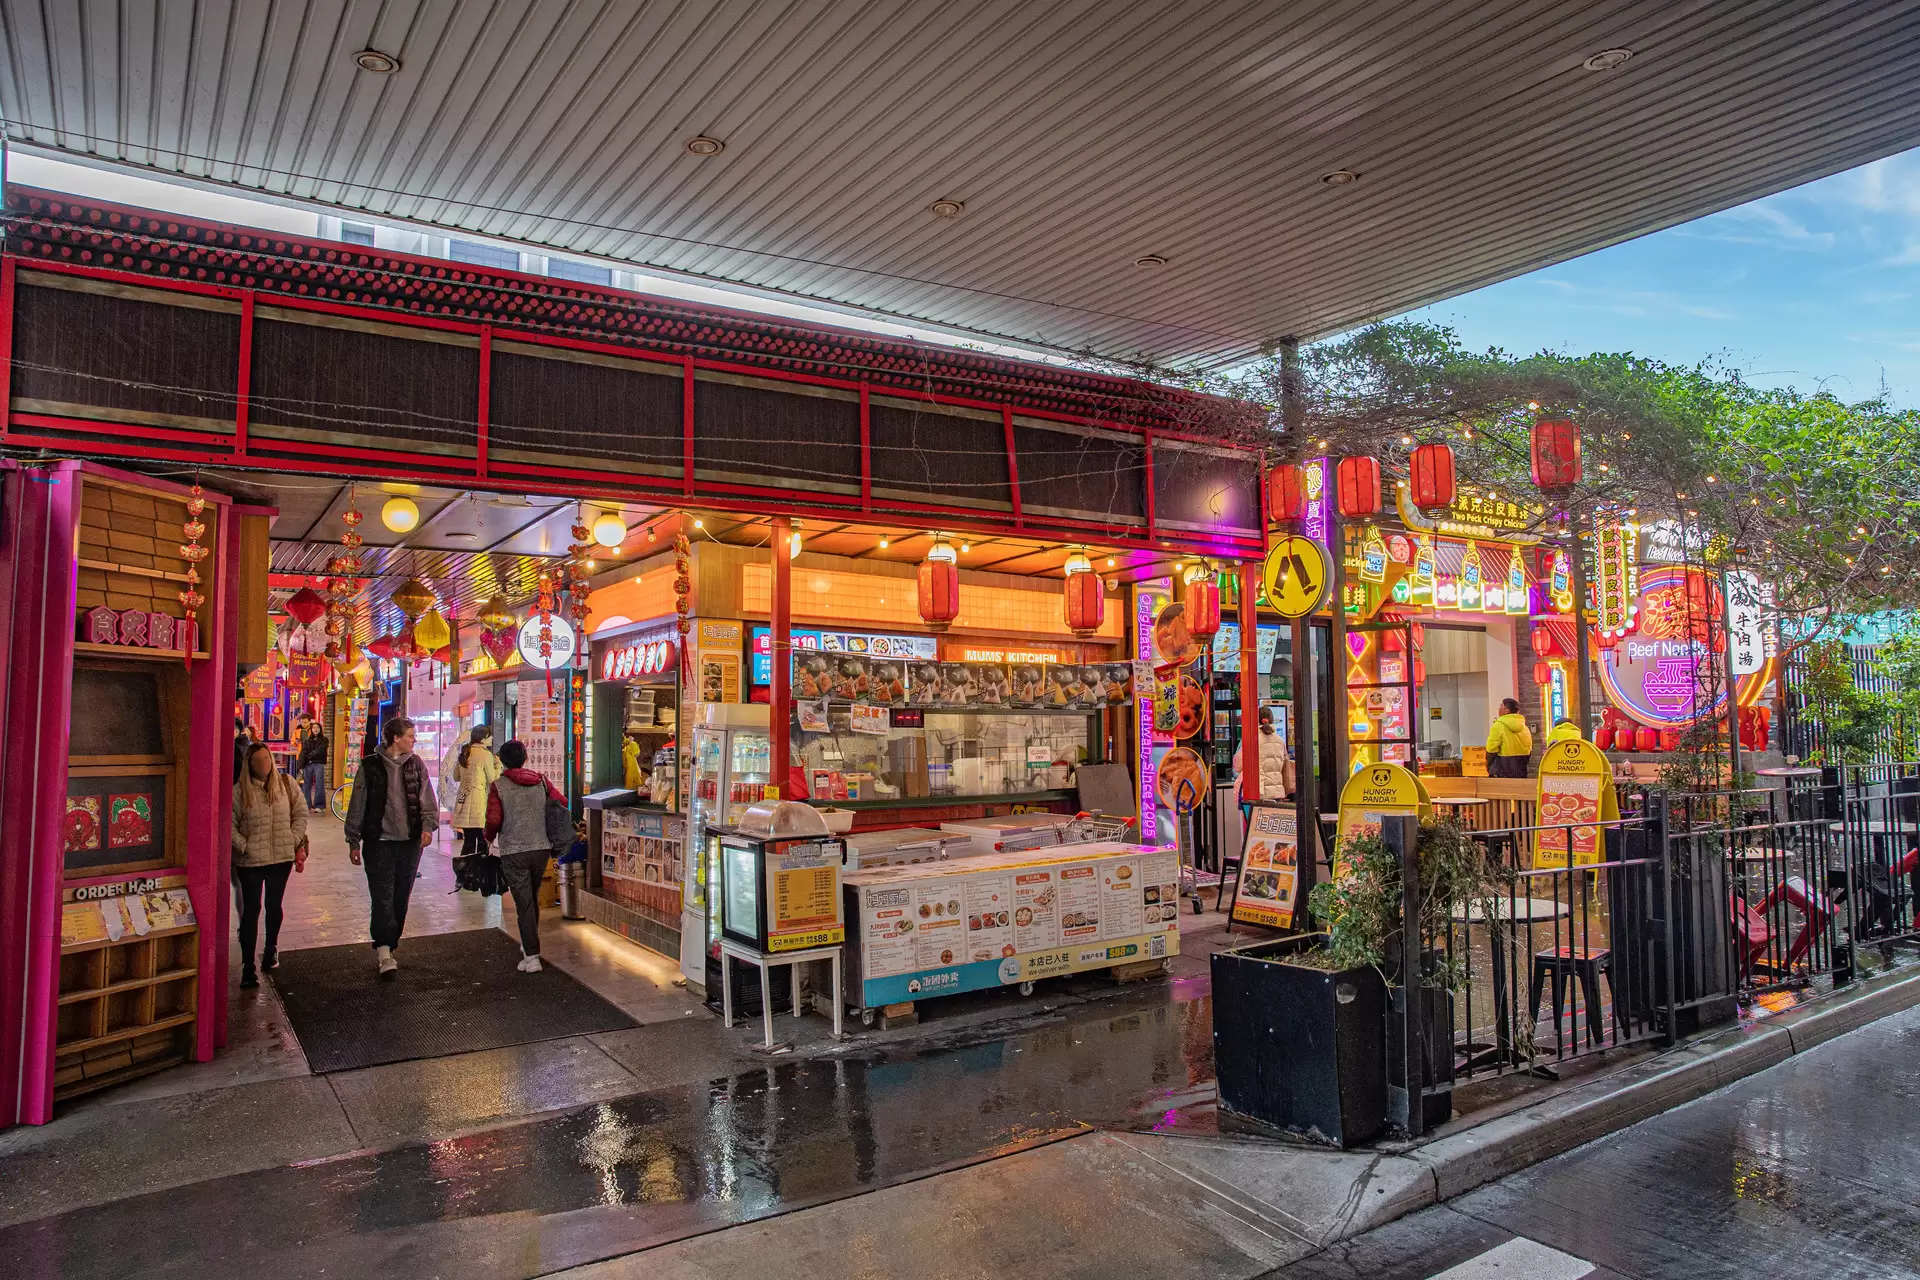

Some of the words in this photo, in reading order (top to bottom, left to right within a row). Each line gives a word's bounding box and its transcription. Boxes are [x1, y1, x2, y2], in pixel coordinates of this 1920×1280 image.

[1452, 512, 1466, 521] Two
[1466, 513, 1482, 523] Peck
[1483, 516, 1502, 528] Crispy
[1366, 556, 1382, 564] TWO
[1628, 567, 1639, 597] Peck
[1628, 640, 1659, 656] Beef
[964, 650, 1004, 662] MUMS'
[1006, 652, 1056, 664] KITCHEN
[1270, 676, 1284, 684] Sprite
[1270, 688, 1285, 697] Sprite
[495, 711, 504, 719] 15
[1363, 788, 1398, 796] HUNGRY
[1145, 800, 1156, 838] 2005
[76, 884, 124, 900] ORDER
[128, 878, 162, 896] HERE
[1028, 952, 1070, 968] 本店已入驻
[1028, 968, 1036, 976] We
[1036, 965, 1057, 974] deliver
[1058, 964, 1070, 972] with
